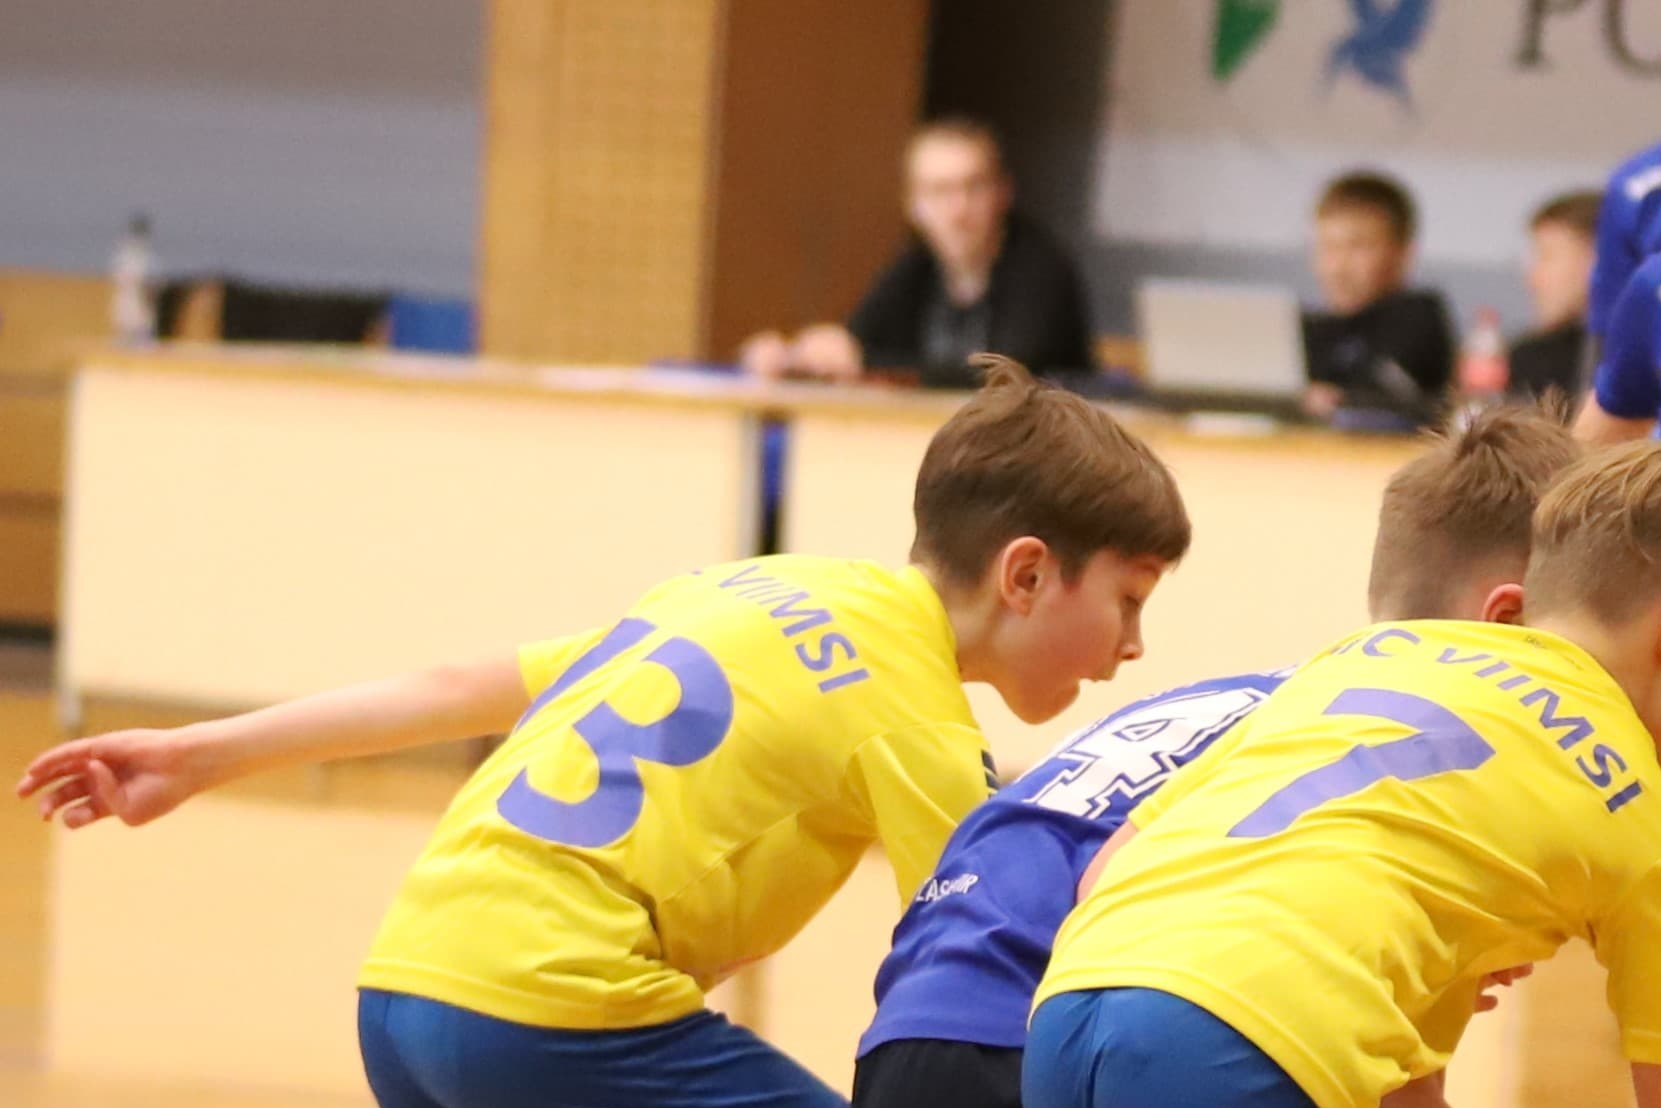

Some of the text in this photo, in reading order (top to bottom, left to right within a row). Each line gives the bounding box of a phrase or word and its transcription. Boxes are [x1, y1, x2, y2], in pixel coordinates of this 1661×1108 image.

[718, 565, 870, 693] VIIMSI
[1226, 687, 1497, 838] 7
[1436, 647, 1643, 813] VIIMSI
